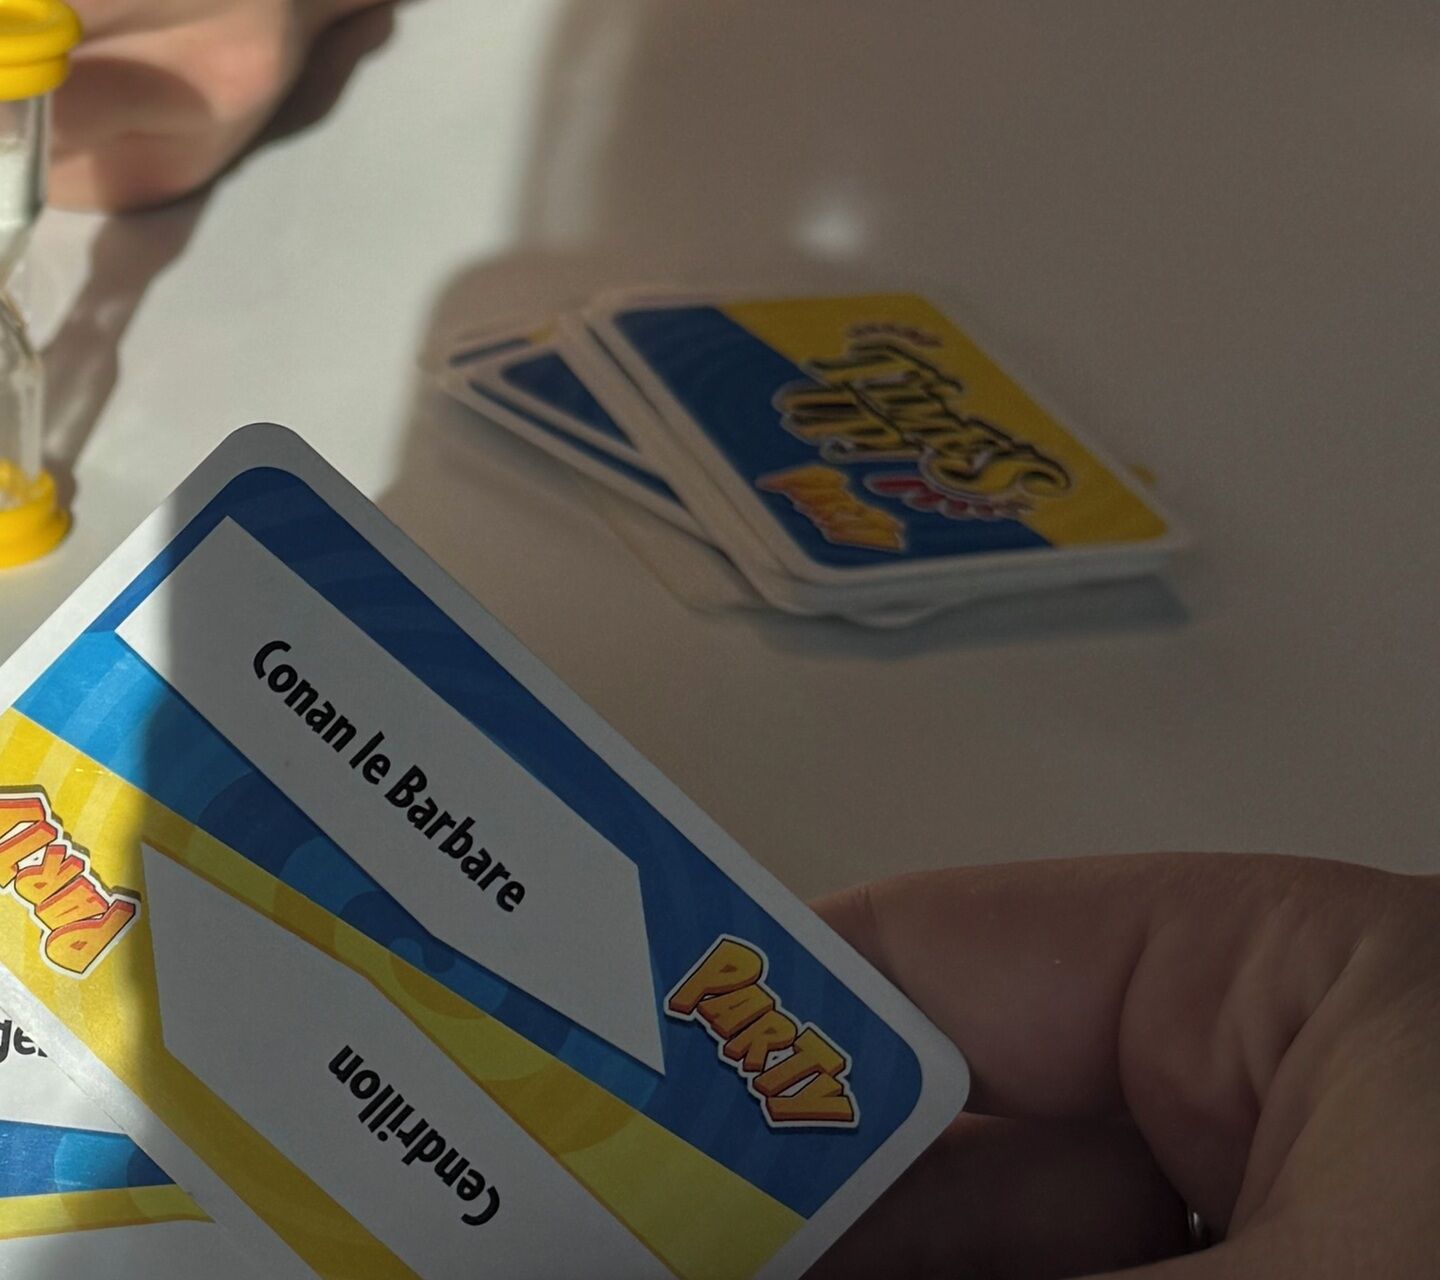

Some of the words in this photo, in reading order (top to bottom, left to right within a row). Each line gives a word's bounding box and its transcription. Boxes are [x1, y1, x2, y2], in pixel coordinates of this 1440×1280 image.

[252, 639, 359, 753] Conan
[347, 729, 392, 786] le
[382, 763, 527, 913] Barbare
[666, 936, 855, 1123] PARTY
[328, 1044, 501, 1227] Cendrillon
